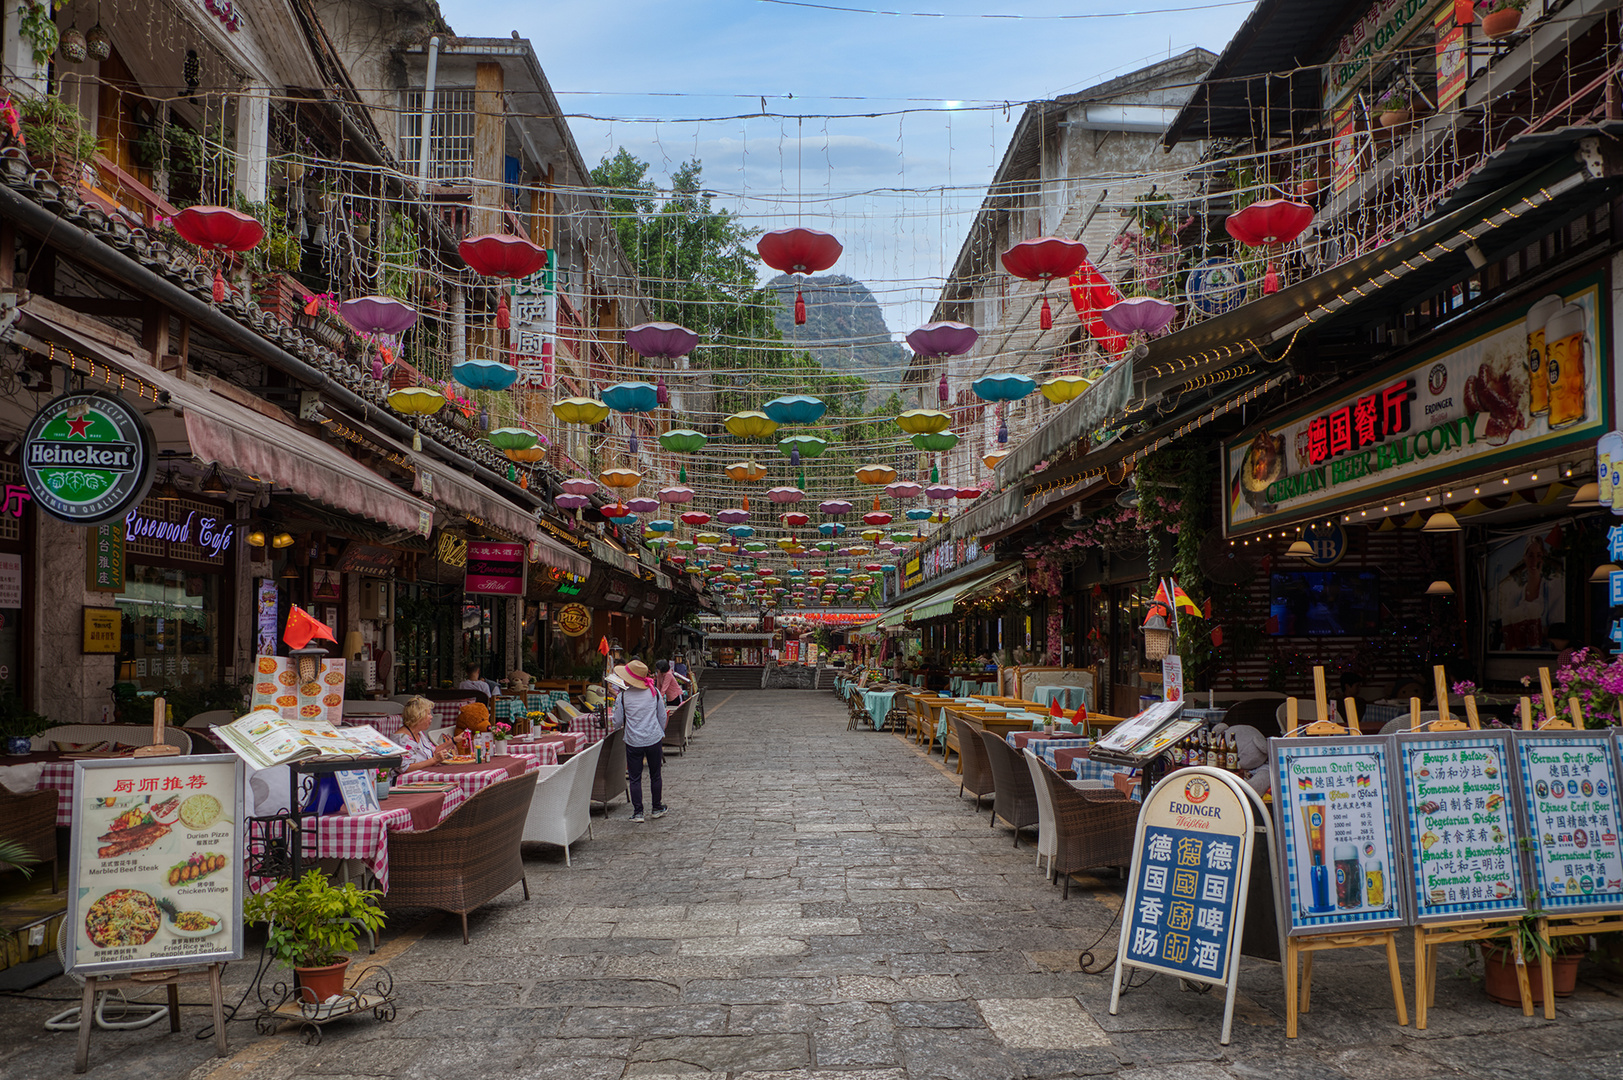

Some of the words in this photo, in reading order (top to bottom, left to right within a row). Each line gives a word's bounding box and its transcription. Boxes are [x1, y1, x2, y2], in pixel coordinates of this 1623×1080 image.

[95, 401, 127, 426] RECIPE
[1425, 397, 1453, 415] ERDINGER
[1308, 380, 1410, 466] 德国餐厅
[31, 444, 129, 466] Heineken
[1266, 465, 1327, 504] GERMAN
[1331, 450, 1373, 485] BEER
[1376, 412, 1480, 472] BALCONY
[35, 485, 76, 513] PREMIUM
[82, 487, 124, 513] QUALITY
[126, 506, 195, 543] Rosewood
[200, 516, 234, 557] Café
[97, 523, 110, 586] 阳台雅座
[112, 525, 121, 586] BALCONY
[469, 547, 523, 557] 玫瑰木酒店
[1312, 539, 1337, 559] HB
[477, 579, 511, 590] Hotel
[559, 612, 589, 626] PIZZA
[136, 656, 190, 678] 国际美食
[1423, 752, 1449, 766] Soups
[1452, 753, 1458, 762] &
[1460, 750, 1488, 764] Salads
[1530, 752, 1560, 764] German
[1562, 752, 1584, 765] Draft
[1586, 752, 1604, 765] Beer
[1293, 764, 1327, 774] German
[1329, 762, 1353, 774] Draft
[1355, 761, 1376, 772] Beer
[1434, 764, 1483, 780] 汤和沙拉
[1549, 763, 1591, 777] 德国生啤
[113, 774, 208, 793] 厨师推荐
[1314, 775, 1356, 788] 德国生啤
[1357, 789, 1378, 799] Black
[1417, 783, 1460, 799] Homemade
[1462, 781, 1501, 795] Sausages
[1169, 801, 1222, 819] ERDINGER
[1439, 797, 1485, 812] 自制香肠
[1539, 802, 1568, 814] Chinese
[1570, 801, 1590, 814] Craft
[1592, 801, 1610, 813] Beer
[1175, 815, 1211, 829] Weißbier
[1424, 815, 1470, 830] Vegetarian
[1471, 812, 1501, 826] Dishes
[1545, 813, 1609, 829] 中国精酿啤酒
[187, 832, 208, 840] Durian
[211, 831, 229, 839] Pizza
[1441, 828, 1488, 844] 素食菜肴
[1422, 849, 1454, 864] Snacks
[1456, 849, 1463, 858] &
[1464, 845, 1510, 860] Sandwiches
[1547, 850, 1591, 863] International
[1594, 849, 1615, 861] Beers
[89, 867, 118, 875] Marbled
[138, 864, 159, 872] Steak
[1432, 857, 1505, 874] 小吃和三明治
[1564, 862, 1606, 877] 国际啤酒
[1428, 874, 1471, 890] Homemade
[1473, 870, 1510, 883] Desserts
[177, 887, 207, 895] Chicken
[207, 886, 229, 894] Wings
[1132, 833, 1173, 958] 德国香肠
[1448, 884, 1495, 901] 自制甜点
[1191, 840, 1234, 972] 德国啤酒
[164, 944, 182, 952] Fried
[197, 946, 227, 954] Seafood
